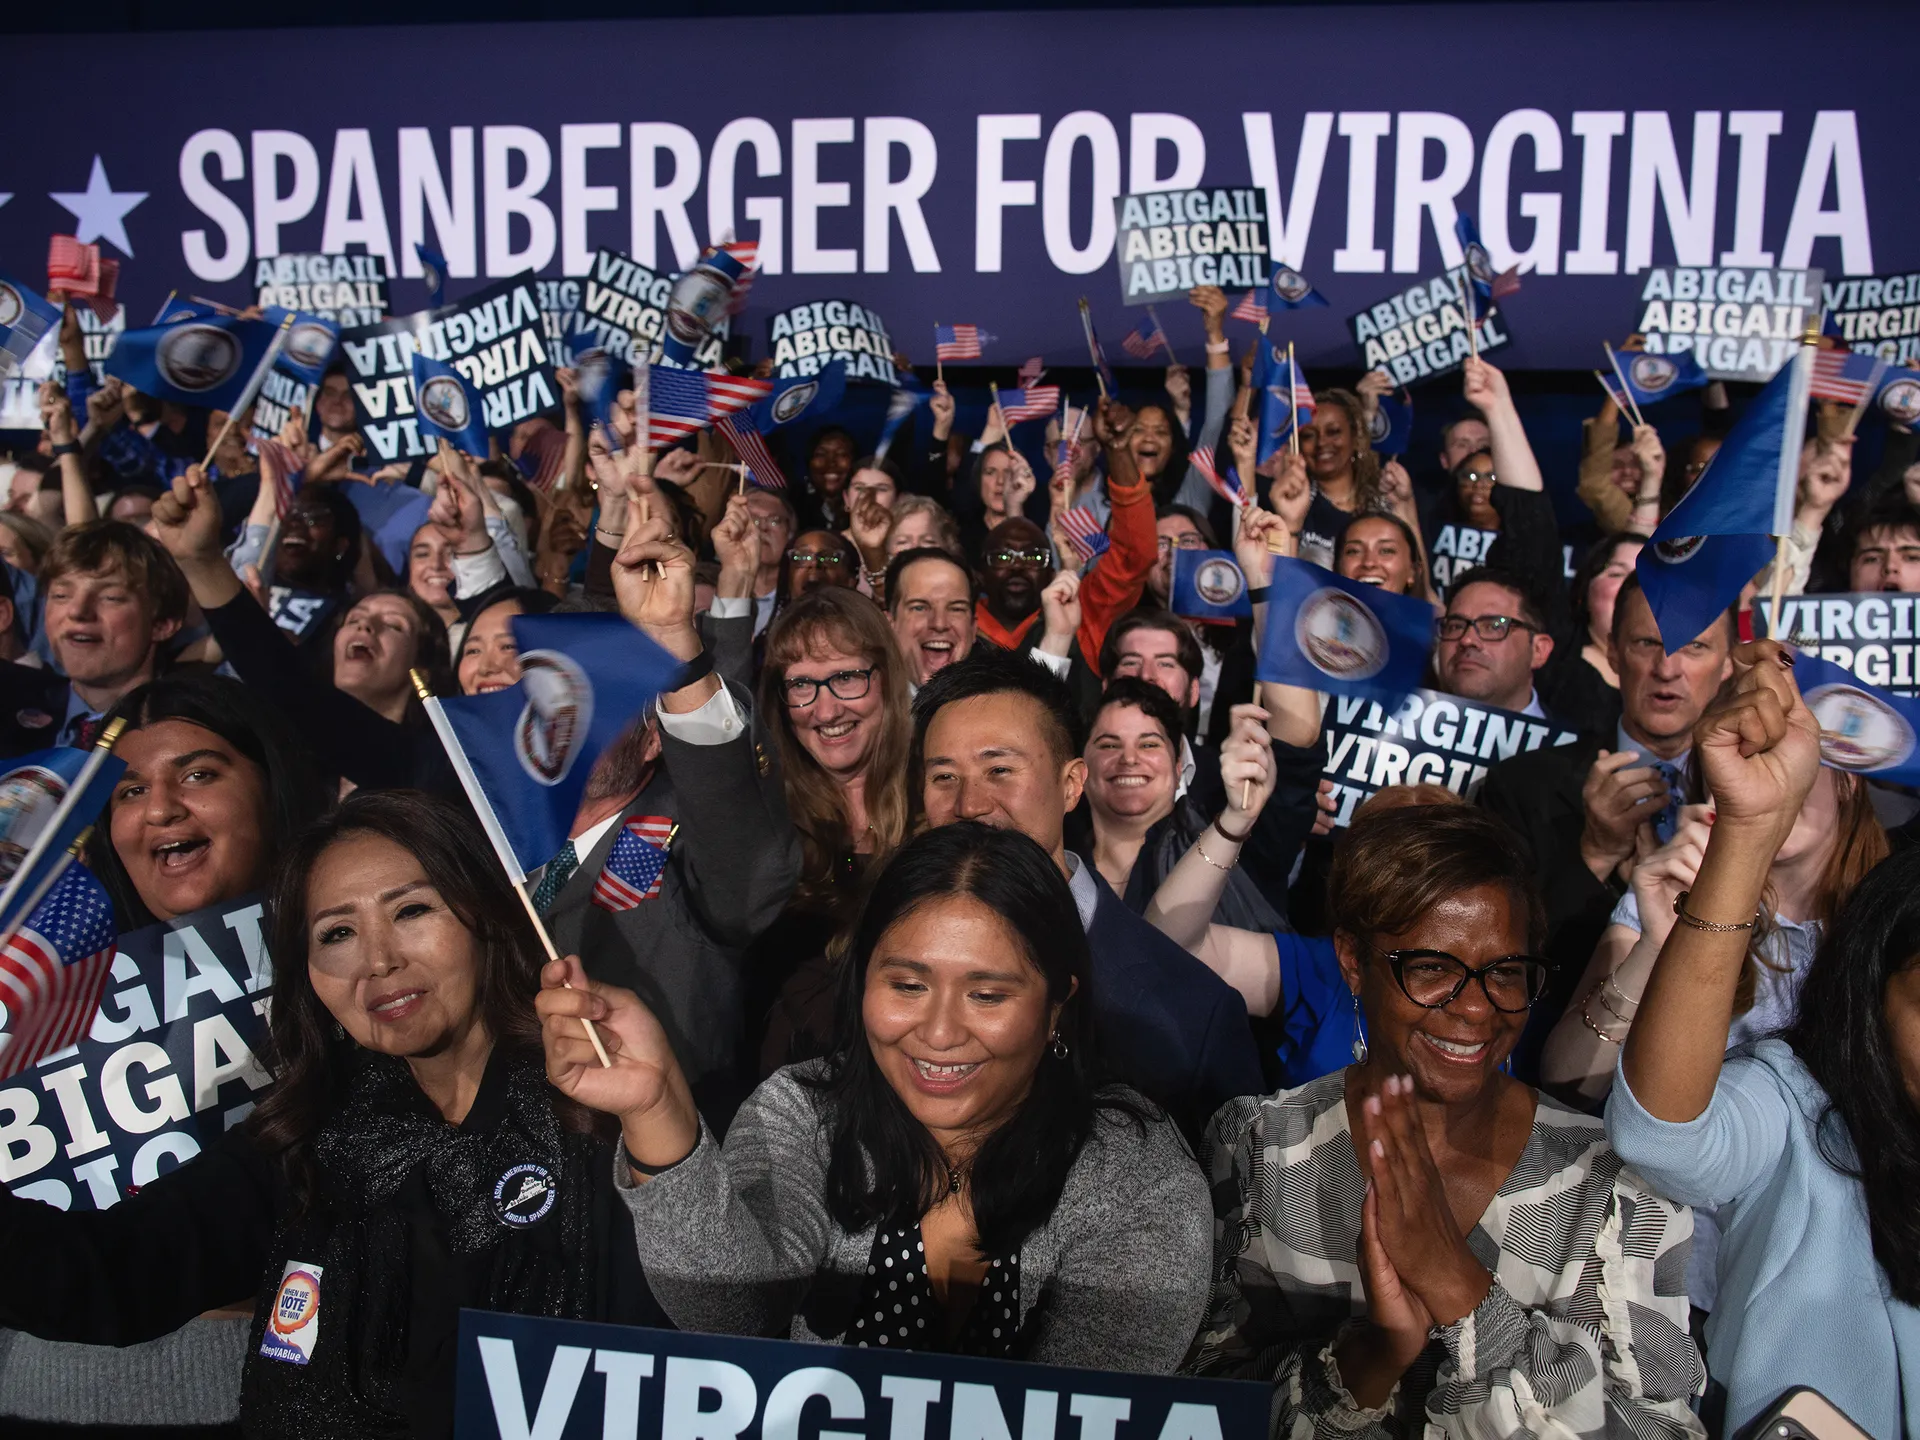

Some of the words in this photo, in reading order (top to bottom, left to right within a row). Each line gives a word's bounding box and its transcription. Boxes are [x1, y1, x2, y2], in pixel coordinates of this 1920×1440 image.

[180, 117, 942, 283] SPANBERGER
[1242, 108, 1874, 277] VIRGINIA
[1121, 189, 1265, 230] ABIGAIL
[1125, 222, 1268, 264] ABIGAIL
[255, 254, 386, 287] ABIGAIL
[1128, 254, 1270, 296] ABIGAIL
[1642, 268, 1814, 306] ABIGAIL
[258, 282, 388, 311] ABIGAIL
[1822, 274, 1920, 312] VIRGI
[771, 300, 891, 342] ABIGAIL
[1639, 301, 1804, 340] ABIGAIL
[775, 326, 896, 367] ABIGAIL
[353, 328, 548, 419] VIRGIA
[363, 371, 556, 460] VIRIA
[1760, 598, 1920, 641] VIRGI
[0, 1010, 276, 1184] BIGA
[494, 1180, 505, 1199] ASIAN
[502, 1164, 536, 1181] AMERICANS
[535, 1165, 548, 1177] FOR
[504, 1211, 528, 1223] ABIGAIL
[529, 1189, 556, 1222] SPANBERGER
[281, 1295, 307, 1312] VOTE
[284, 1288, 299, 1297] WHEN
[299, 1291, 309, 1299] WE
[280, 1309, 288, 1318] WE
[287, 1311, 301, 1321] WIN
